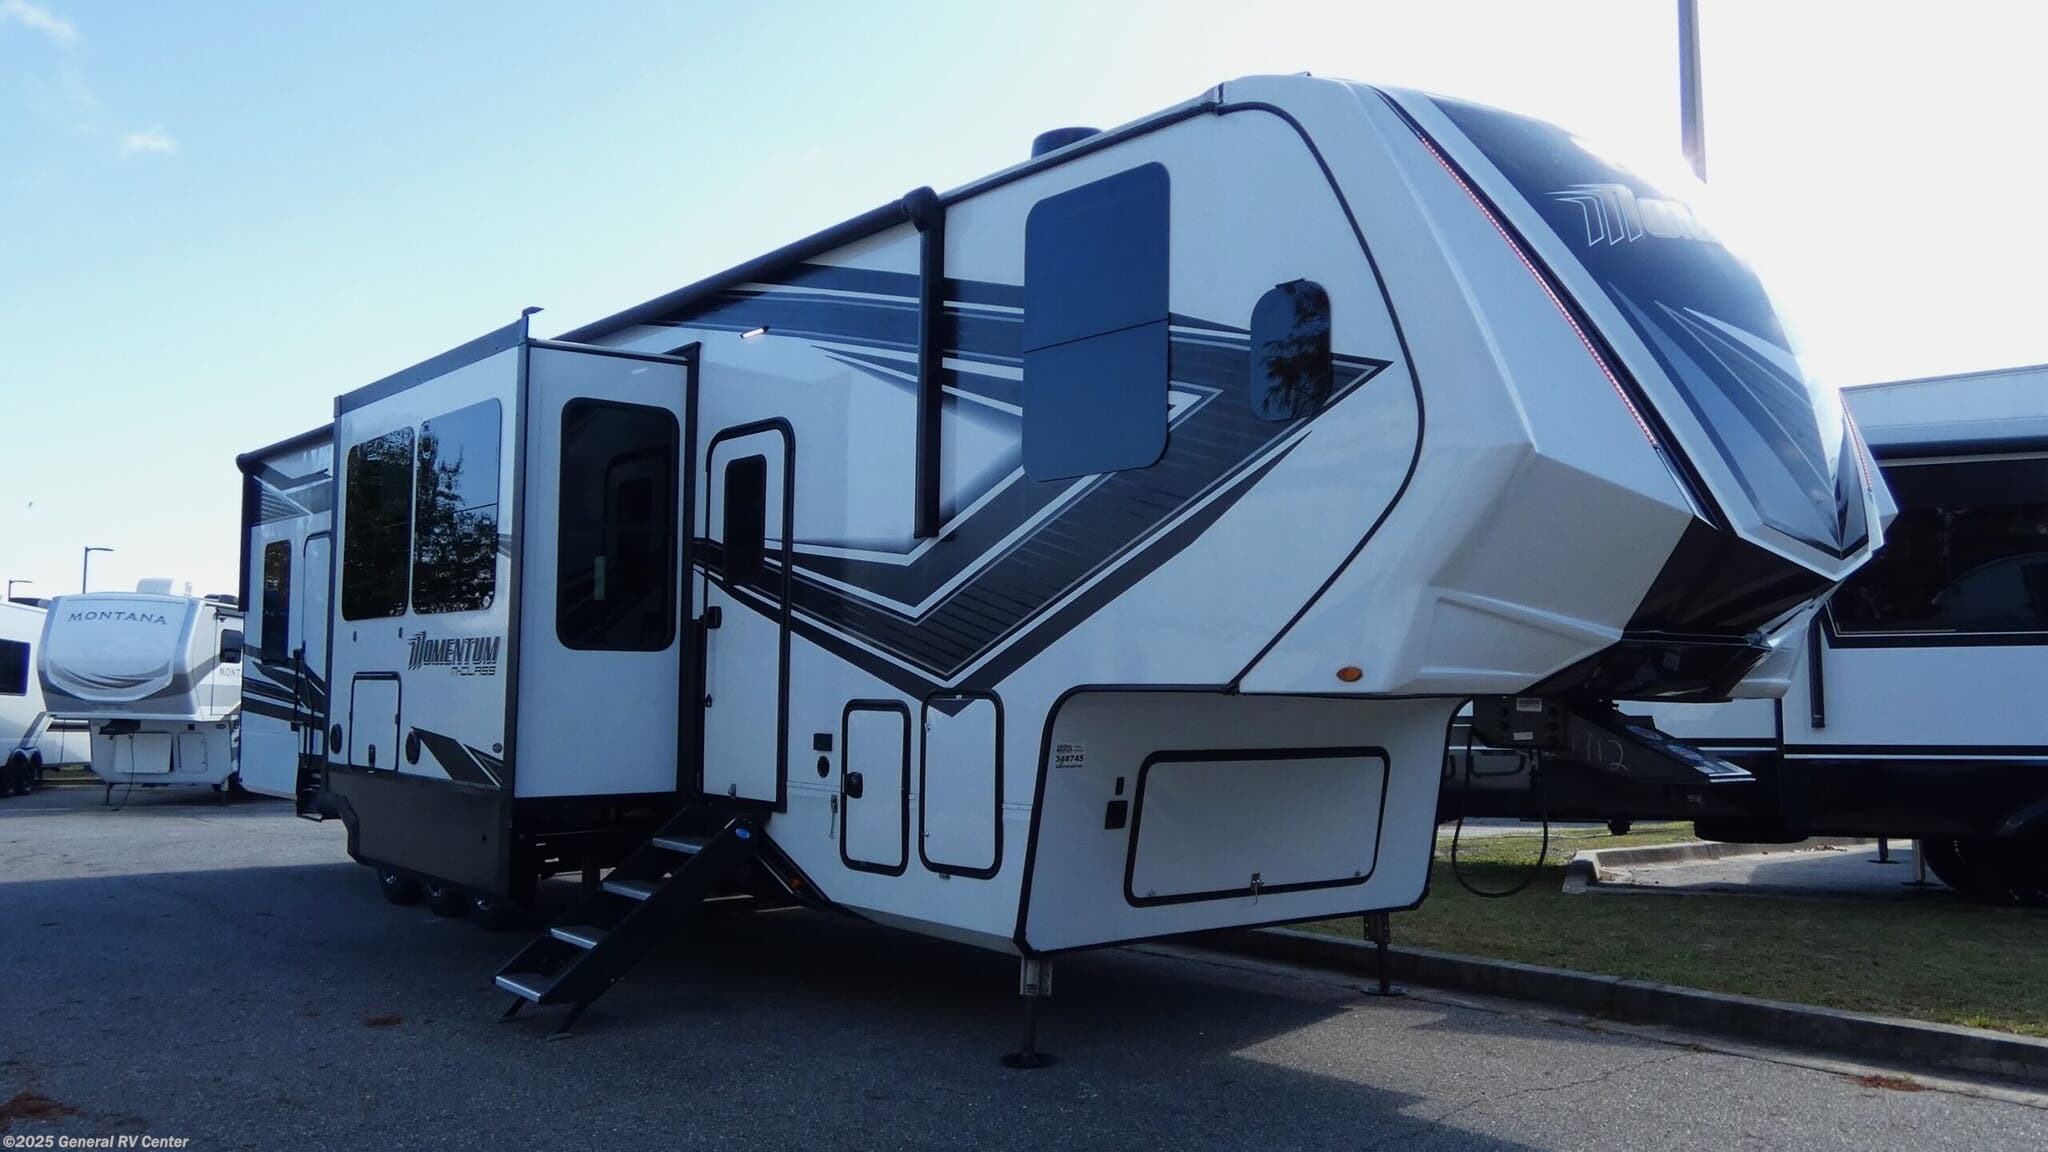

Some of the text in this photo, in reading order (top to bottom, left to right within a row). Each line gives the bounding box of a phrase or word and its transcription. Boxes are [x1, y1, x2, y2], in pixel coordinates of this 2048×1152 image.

[68, 611, 167, 625] MONTANA
[408, 631, 501, 671] MOMENTUM
[219, 667, 242, 678] MONT
